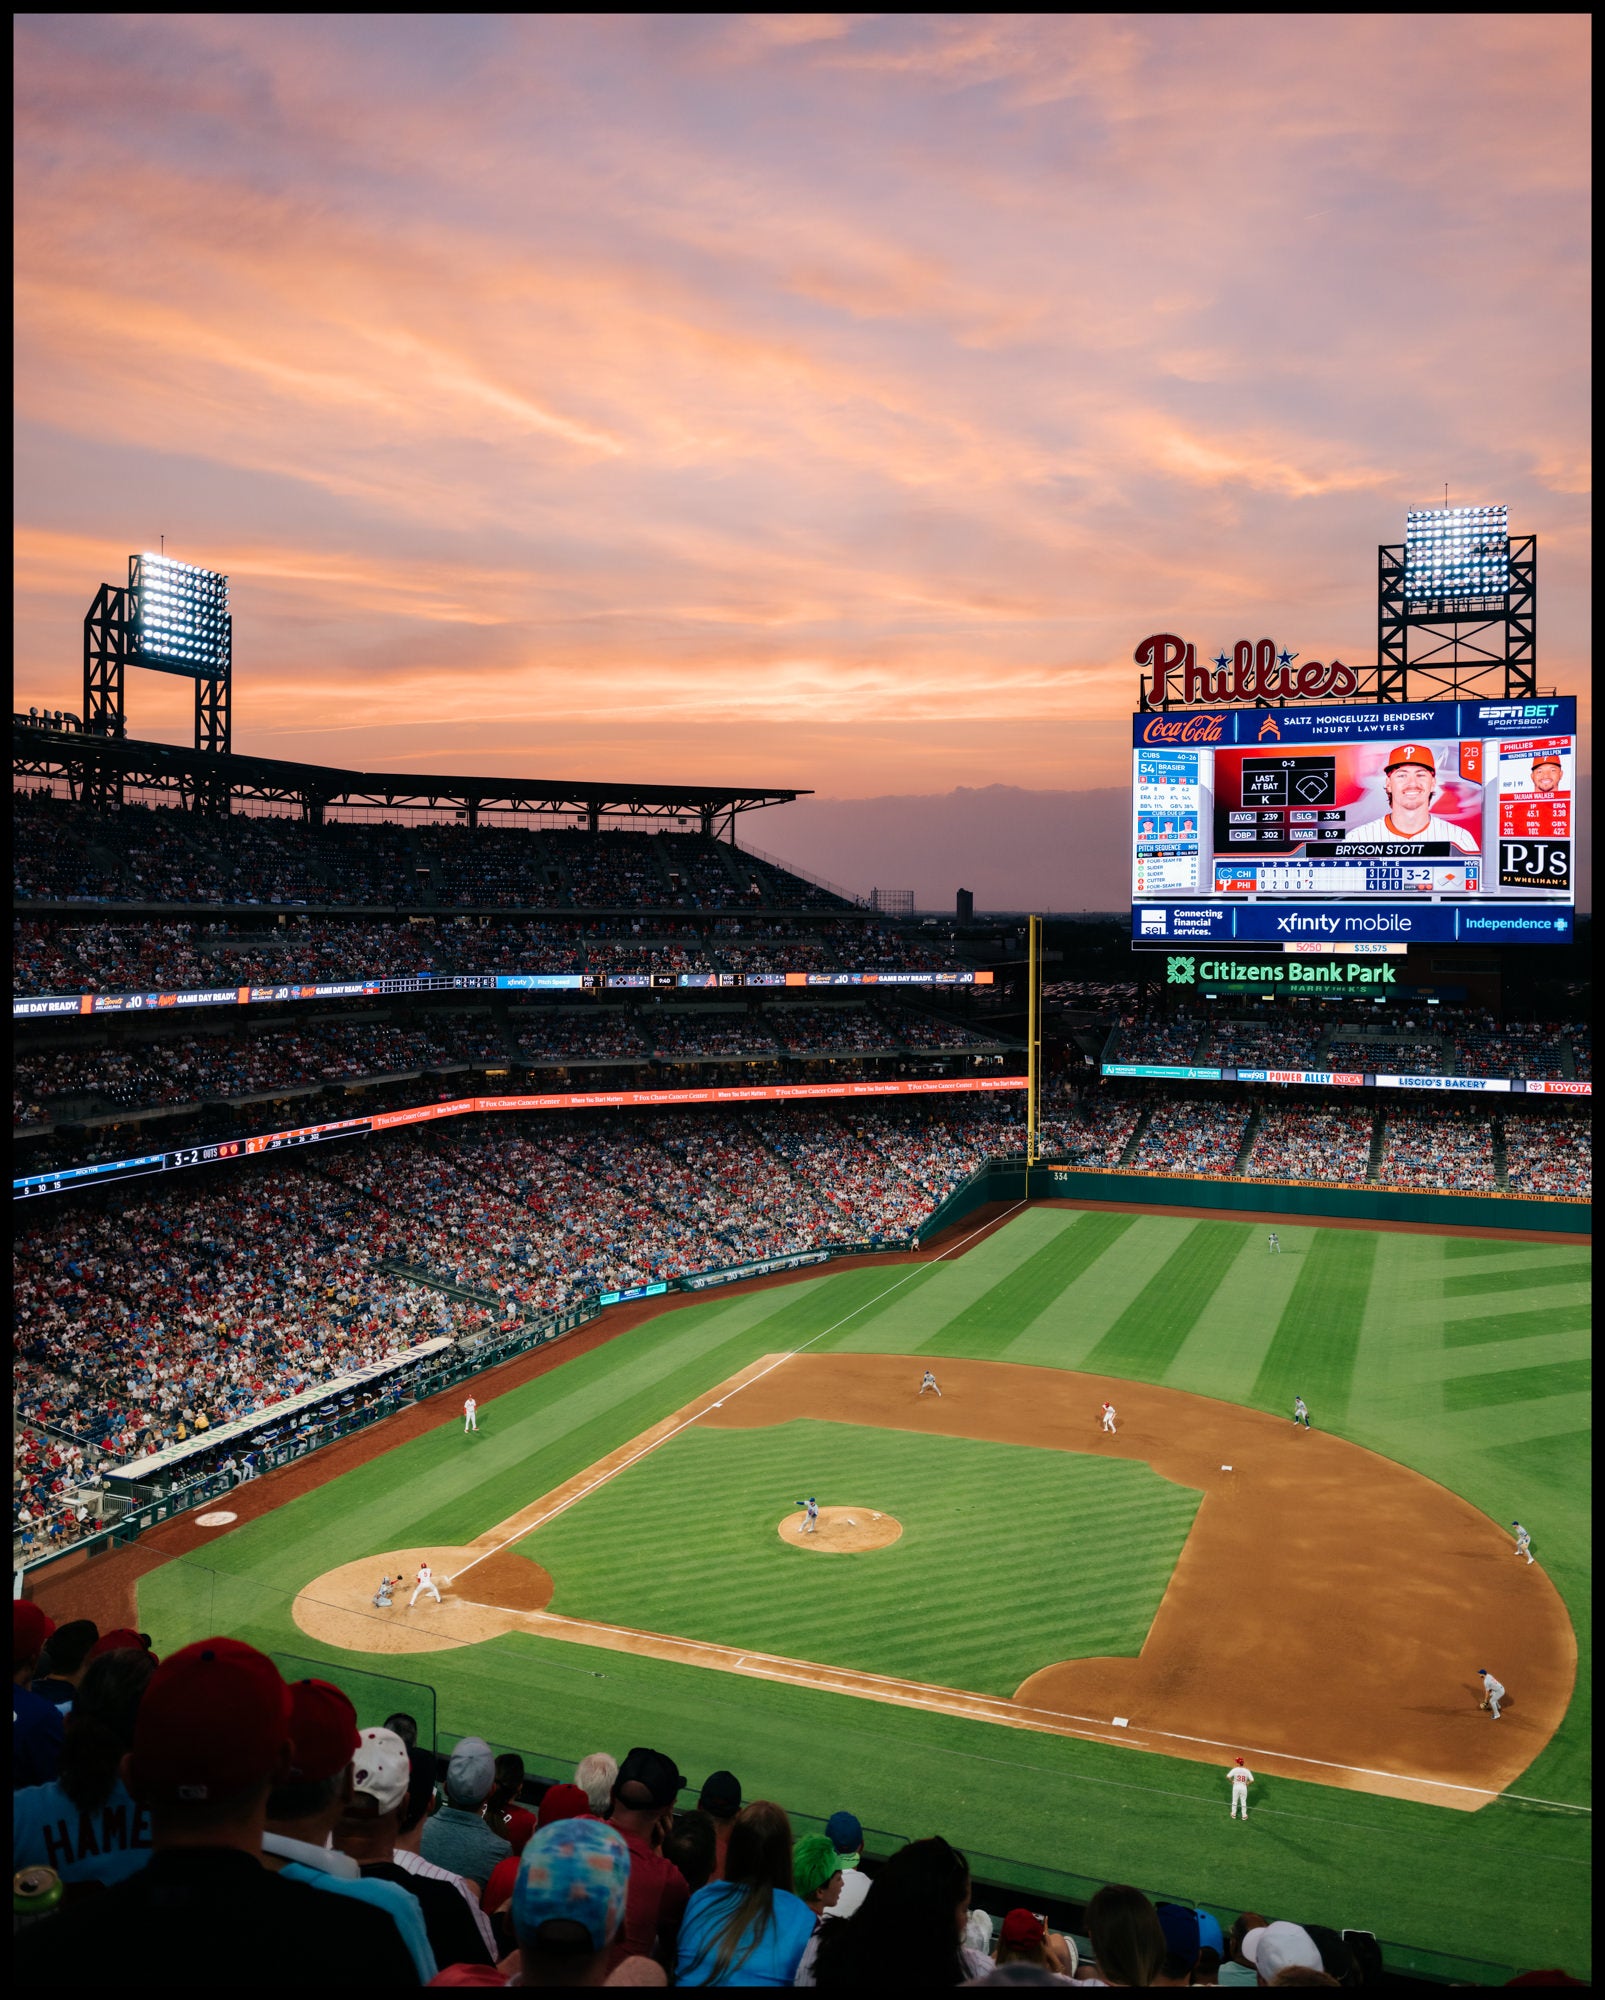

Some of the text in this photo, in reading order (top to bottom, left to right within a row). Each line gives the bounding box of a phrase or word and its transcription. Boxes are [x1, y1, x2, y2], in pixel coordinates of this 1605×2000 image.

[1134, 632, 1358, 706] Phillies
[1284, 712, 1435, 725] SALTZ MONGELUZZI BENDESKY
[1488, 718, 1550, 726] SPORTSBOOK
[1143, 715, 1228, 743] Coca-Cola
[1312, 724, 1405, 734] INJURY LAWYERS
[1504, 742, 1534, 751] PHILLIES
[1464, 747, 1479, 758] 2B
[1140, 764, 1155, 773] 54
[1468, 761, 1475, 771] 5
[1261, 796, 1269, 804] K
[1335, 845, 1424, 855] BRYSON STOTT
[1502, 844, 1567, 875] PJs
[1261, 870, 1265, 878] 0
[1308, 870, 1313, 878] 0
[1407, 870, 1430, 880] 3-2
[1469, 869, 1474, 877] 3
[1261, 881, 1265, 889] 0
[1273, 881, 1277, 889] 2
[1285, 881, 1289, 889] 0
[1296, 881, 1301, 889] 0
[1308, 881, 1313, 889] 2
[1369, 881, 1375, 889] 4
[1382, 881, 1387, 889] 8
[1469, 881, 1474, 889] 3
[1514, 877, 1567, 886] WHELIHAN'S
[1174, 910, 1223, 919] Connecting
[1174, 918, 1211, 927] financial
[1277, 913, 1412, 933] xfinity mobile
[1466, 918, 1552, 930] Independence
[1174, 927, 1211, 936] services.
[1354, 945, 1387, 953] $35,575
[1199, 962, 1396, 983] Citizens Bank Park
[280, 988, 288, 997] 10
[315, 987, 333, 995] GAME
[130, 996, 142, 1007] 10
[177, 994, 198, 1003] GAME
[198, 993, 212, 1002] DAY
[213, 992, 236, 1001] READY.
[30, 1003, 48, 1012] DAY
[49, 1001, 78, 1011] READY.
[1269, 1072, 1331, 1083] POWER ALLEY
[1335, 1075, 1360, 1083] NECA
[1399, 1078, 1486, 1089] LISCIO'S BAKERY
[1549, 1083, 1592, 1093] TOYOTA
[203, 1148, 218, 1159] OUTS
[1054, 1172, 1068, 1180] 334
[1202, 1174, 1242, 1182] ASPLUNDH
[24, 1181, 61, 1195] 5 10 15
[1448, 1190, 1492, 1198] ASPLUNDH
[1500, 1193, 1545, 1201] ASPLUNDH
[697, 1279, 704, 1287] 10
